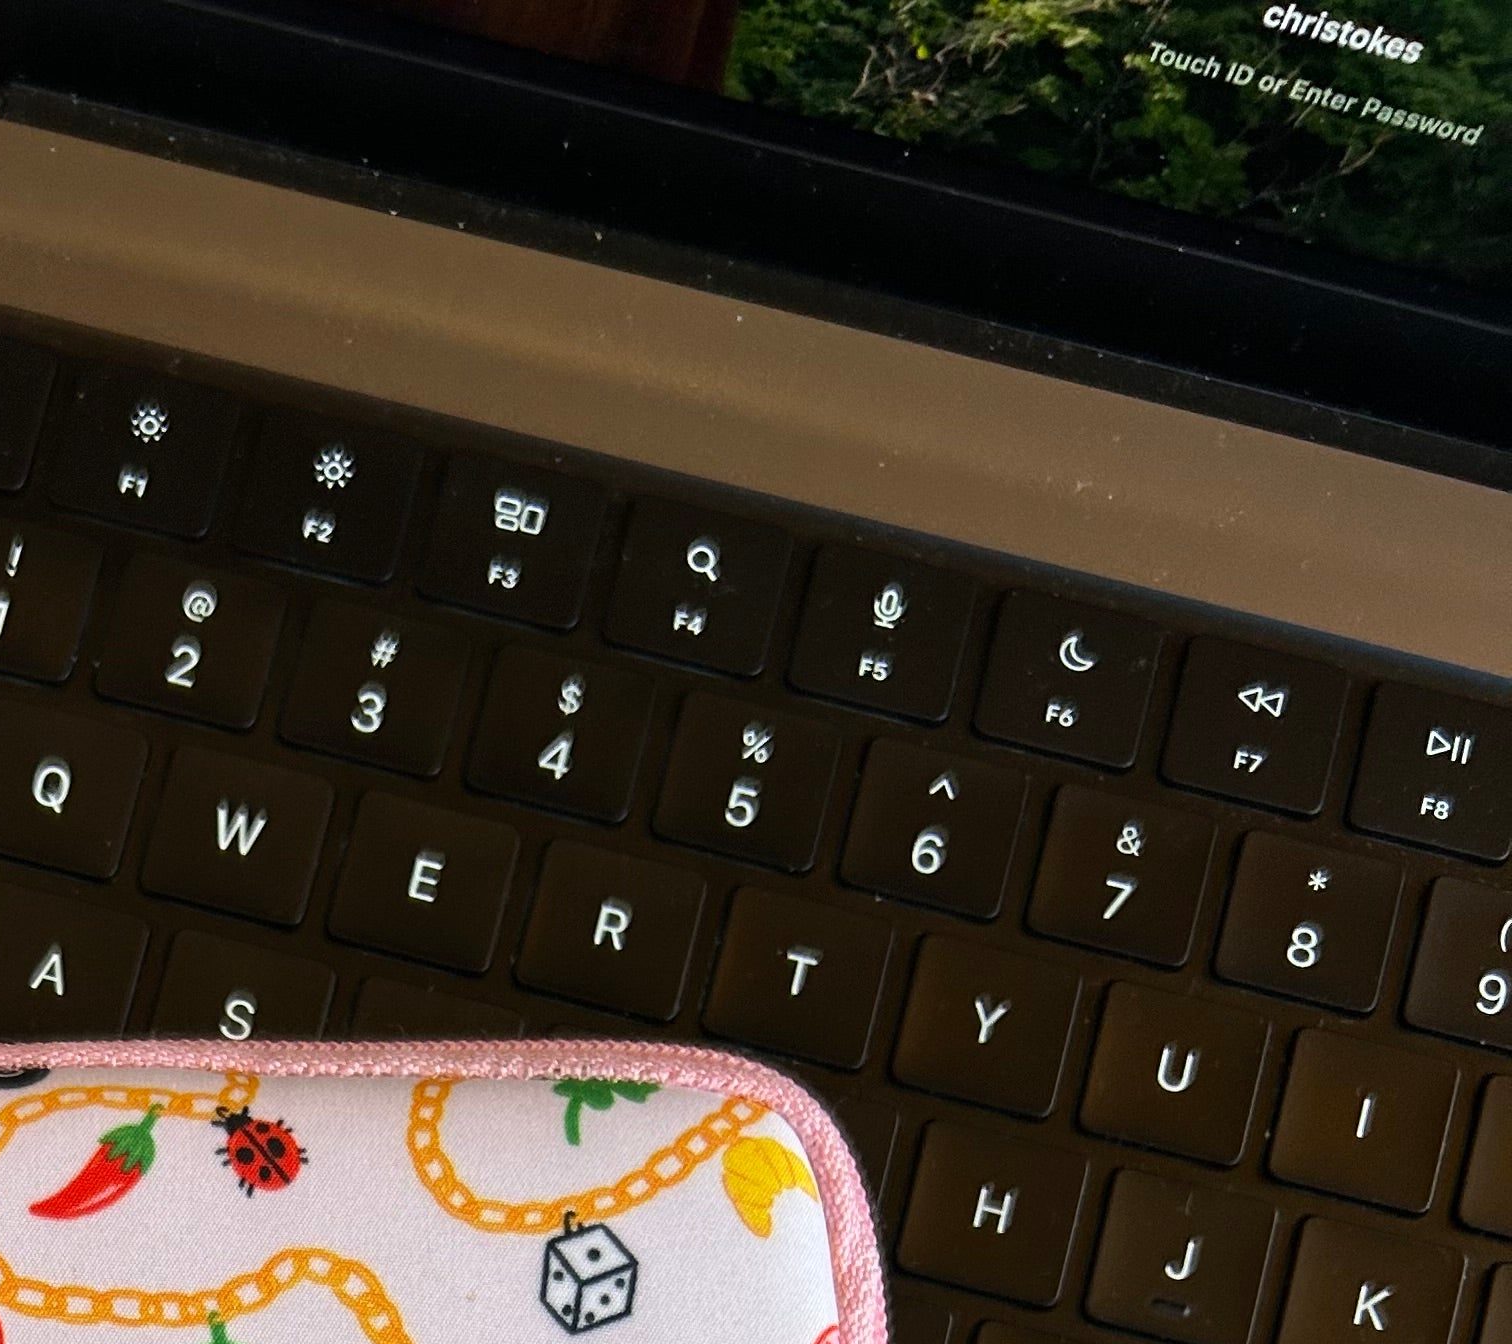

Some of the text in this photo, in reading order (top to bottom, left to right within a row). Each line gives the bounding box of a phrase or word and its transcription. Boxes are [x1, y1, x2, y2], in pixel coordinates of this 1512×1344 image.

[1263, 3, 1424, 64] christokes
[1150, 41, 1485, 147] Touch ID or Enter Password
[120, 474, 147, 498] F1
[303, 519, 334, 543] F2
[488, 565, 518, 589] F3
[183, 591, 215, 623] @
[673, 611, 702, 636] F4
[167, 645, 200, 688] 2
[371, 640, 397, 668] #
[858, 657, 888, 681] F5
[351, 691, 385, 733] 3
[558, 683, 581, 716] $
[1045, 704, 1074, 727] F6
[538, 740, 570, 780] 4
[742, 730, 770, 764] %
[1233, 750, 1263, 773] F7
[33, 765, 70, 814] Q
[725, 785, 758, 827] 5
[1420, 797, 1450, 820] F8
[217, 808, 266, 856] W
[1116, 826, 1141, 857] &
[911, 834, 944, 874] 6
[408, 858, 443, 903] E
[1103, 879, 1133, 920] 7
[594, 905, 628, 951] R
[1286, 926, 1318, 968] 8
[30, 953, 63, 996] A
[787, 953, 818, 996] T
[1476, 973, 1507, 1015] 9
[220, 999, 255, 1041] S
[975, 1001, 1007, 1044] Y
[1157, 1047, 1194, 1092] U
[1356, 1098, 1371, 1138] I
[973, 1187, 1012, 1234] H
[1164, 1241, 1195, 1281] J
[1353, 1284, 1390, 1331] K
